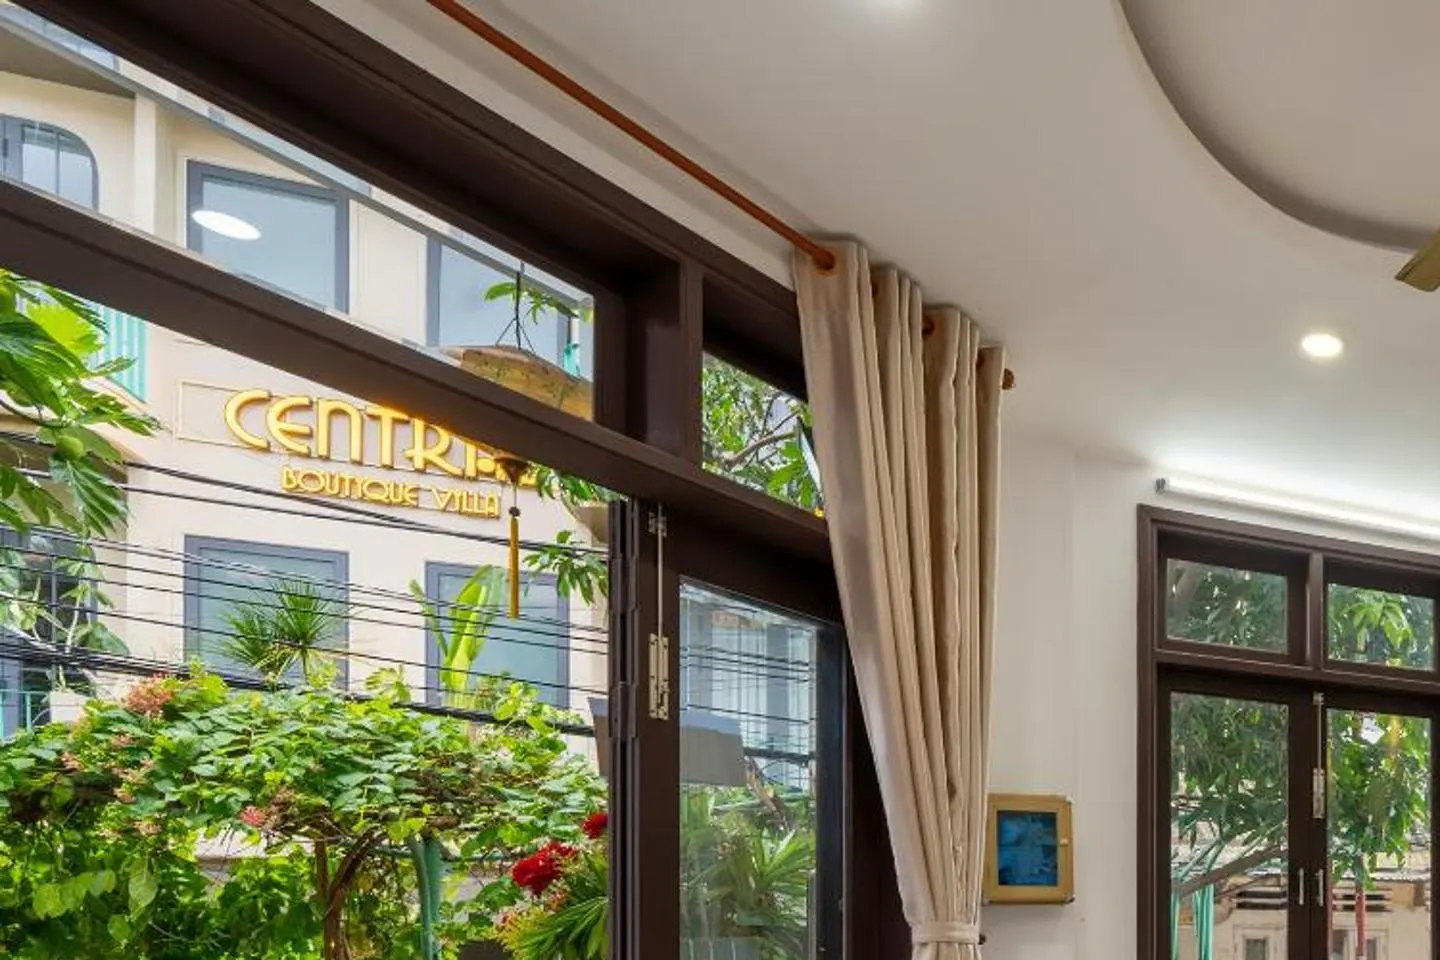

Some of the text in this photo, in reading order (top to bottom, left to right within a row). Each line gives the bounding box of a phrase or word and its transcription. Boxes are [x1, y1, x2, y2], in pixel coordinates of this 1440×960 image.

[224, 388, 537, 487] CENTRA
[282, 464, 500, 520] BOUTIQUE VILLA
